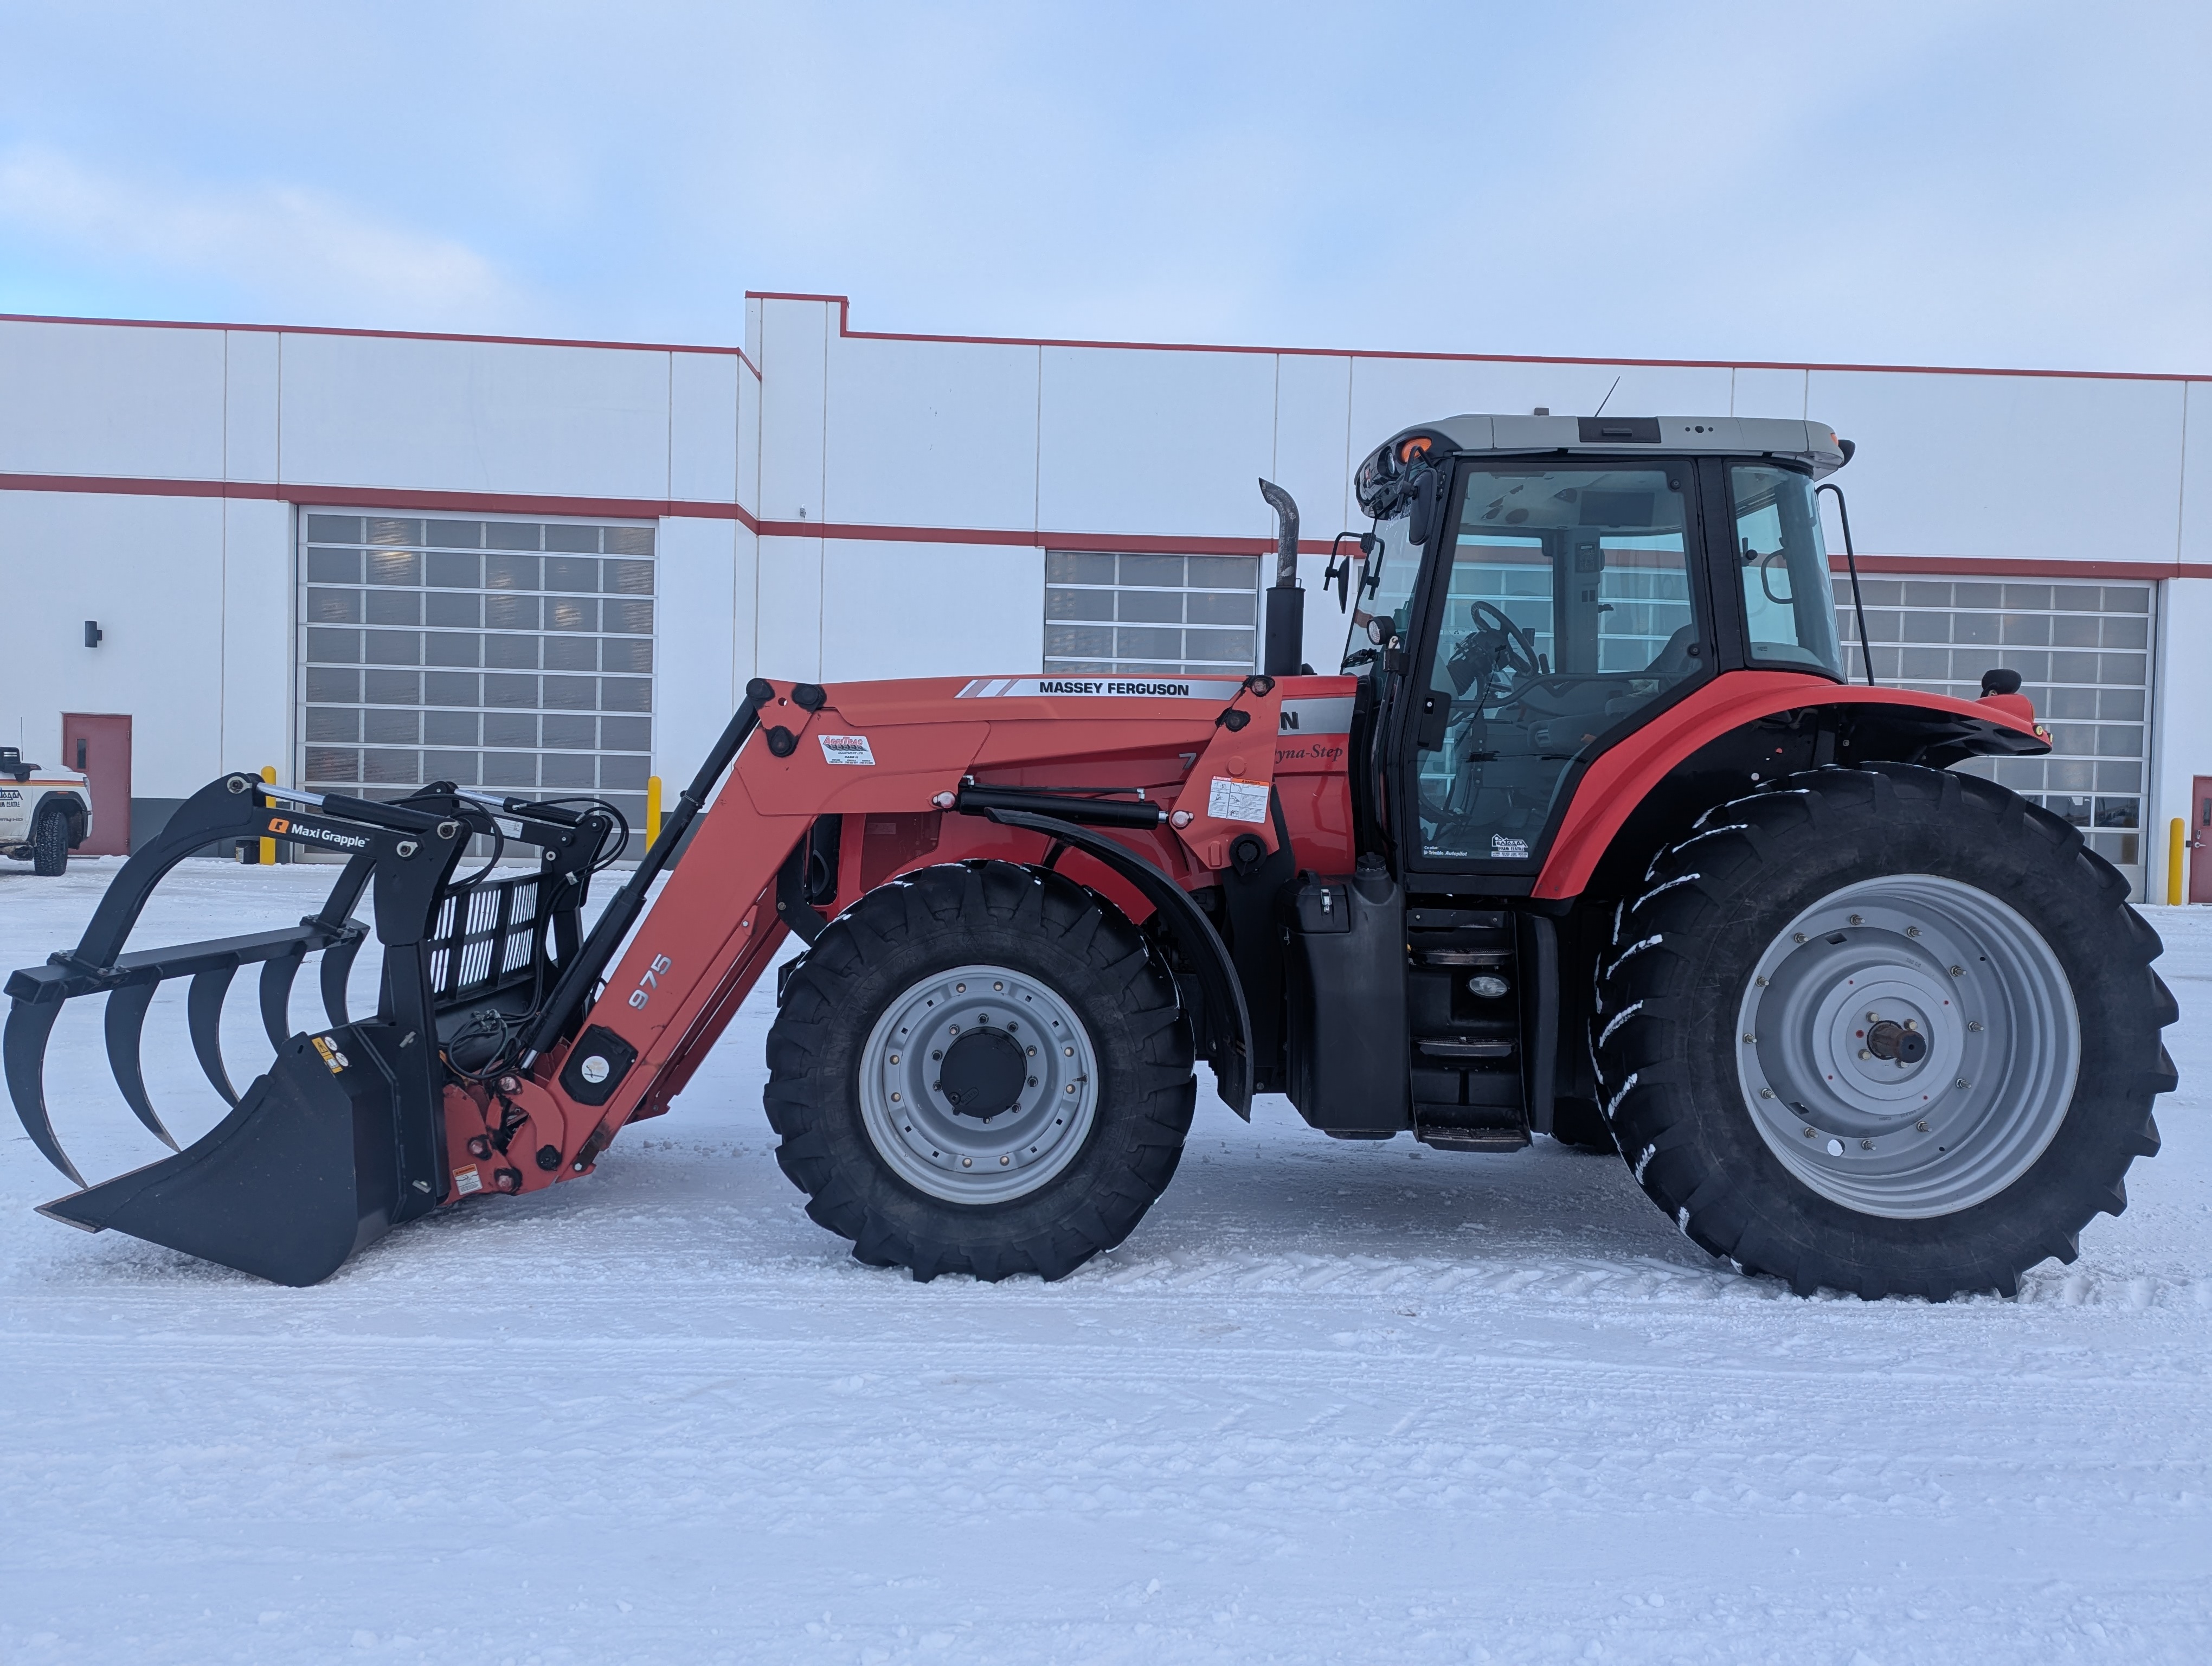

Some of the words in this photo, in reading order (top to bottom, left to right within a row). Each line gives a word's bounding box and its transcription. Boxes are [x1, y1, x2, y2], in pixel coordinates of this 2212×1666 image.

[1040, 682, 1103, 694] MASSEY
[1108, 683, 1189, 696] FERGUSON
[1275, 744, 1343, 764] yna-Step
[291, 823, 320, 838] Maxi
[628, 953, 672, 1010] 975
